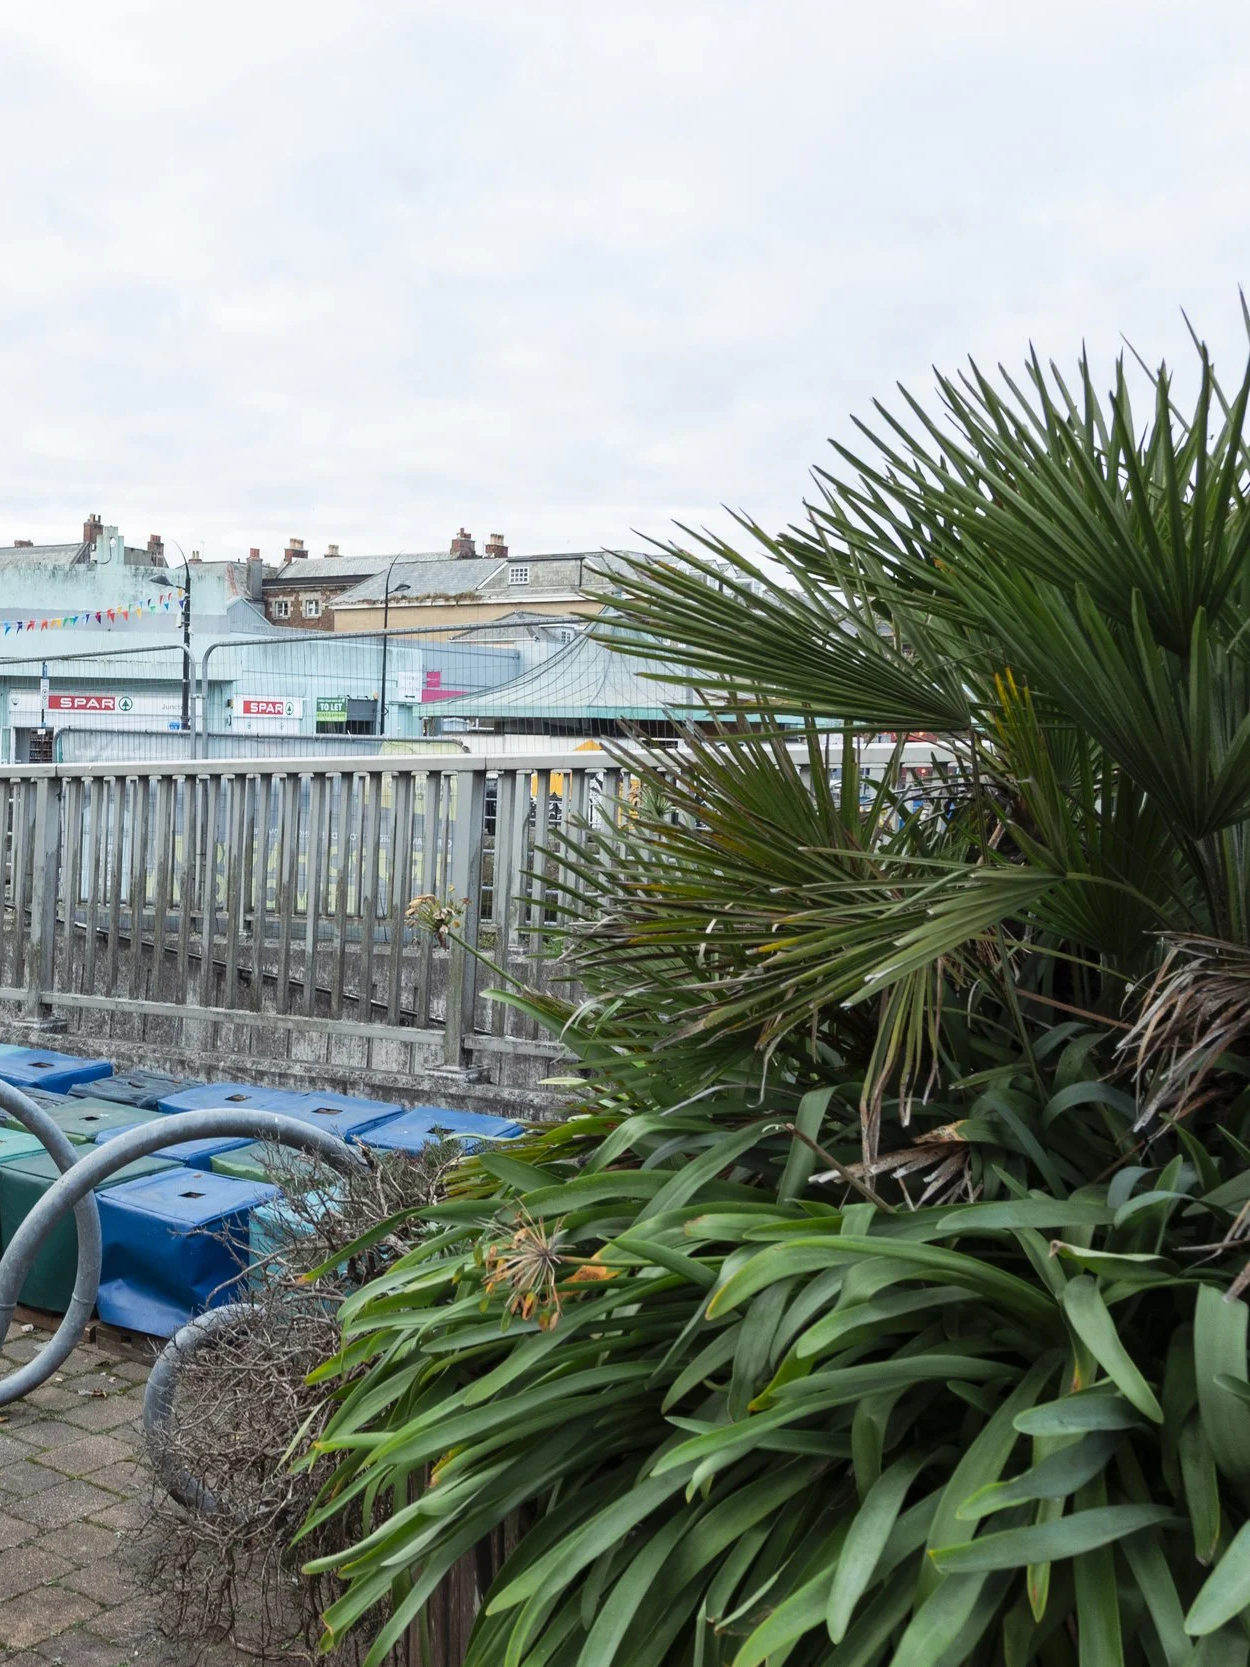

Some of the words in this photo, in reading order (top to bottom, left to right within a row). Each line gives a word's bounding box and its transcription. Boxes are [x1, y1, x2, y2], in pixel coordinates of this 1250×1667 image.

[60, 697, 114, 709] SPAR
[250, 703, 283, 714] SPAR
[320, 703, 330, 711] TO
[330, 703, 343, 711] LET
